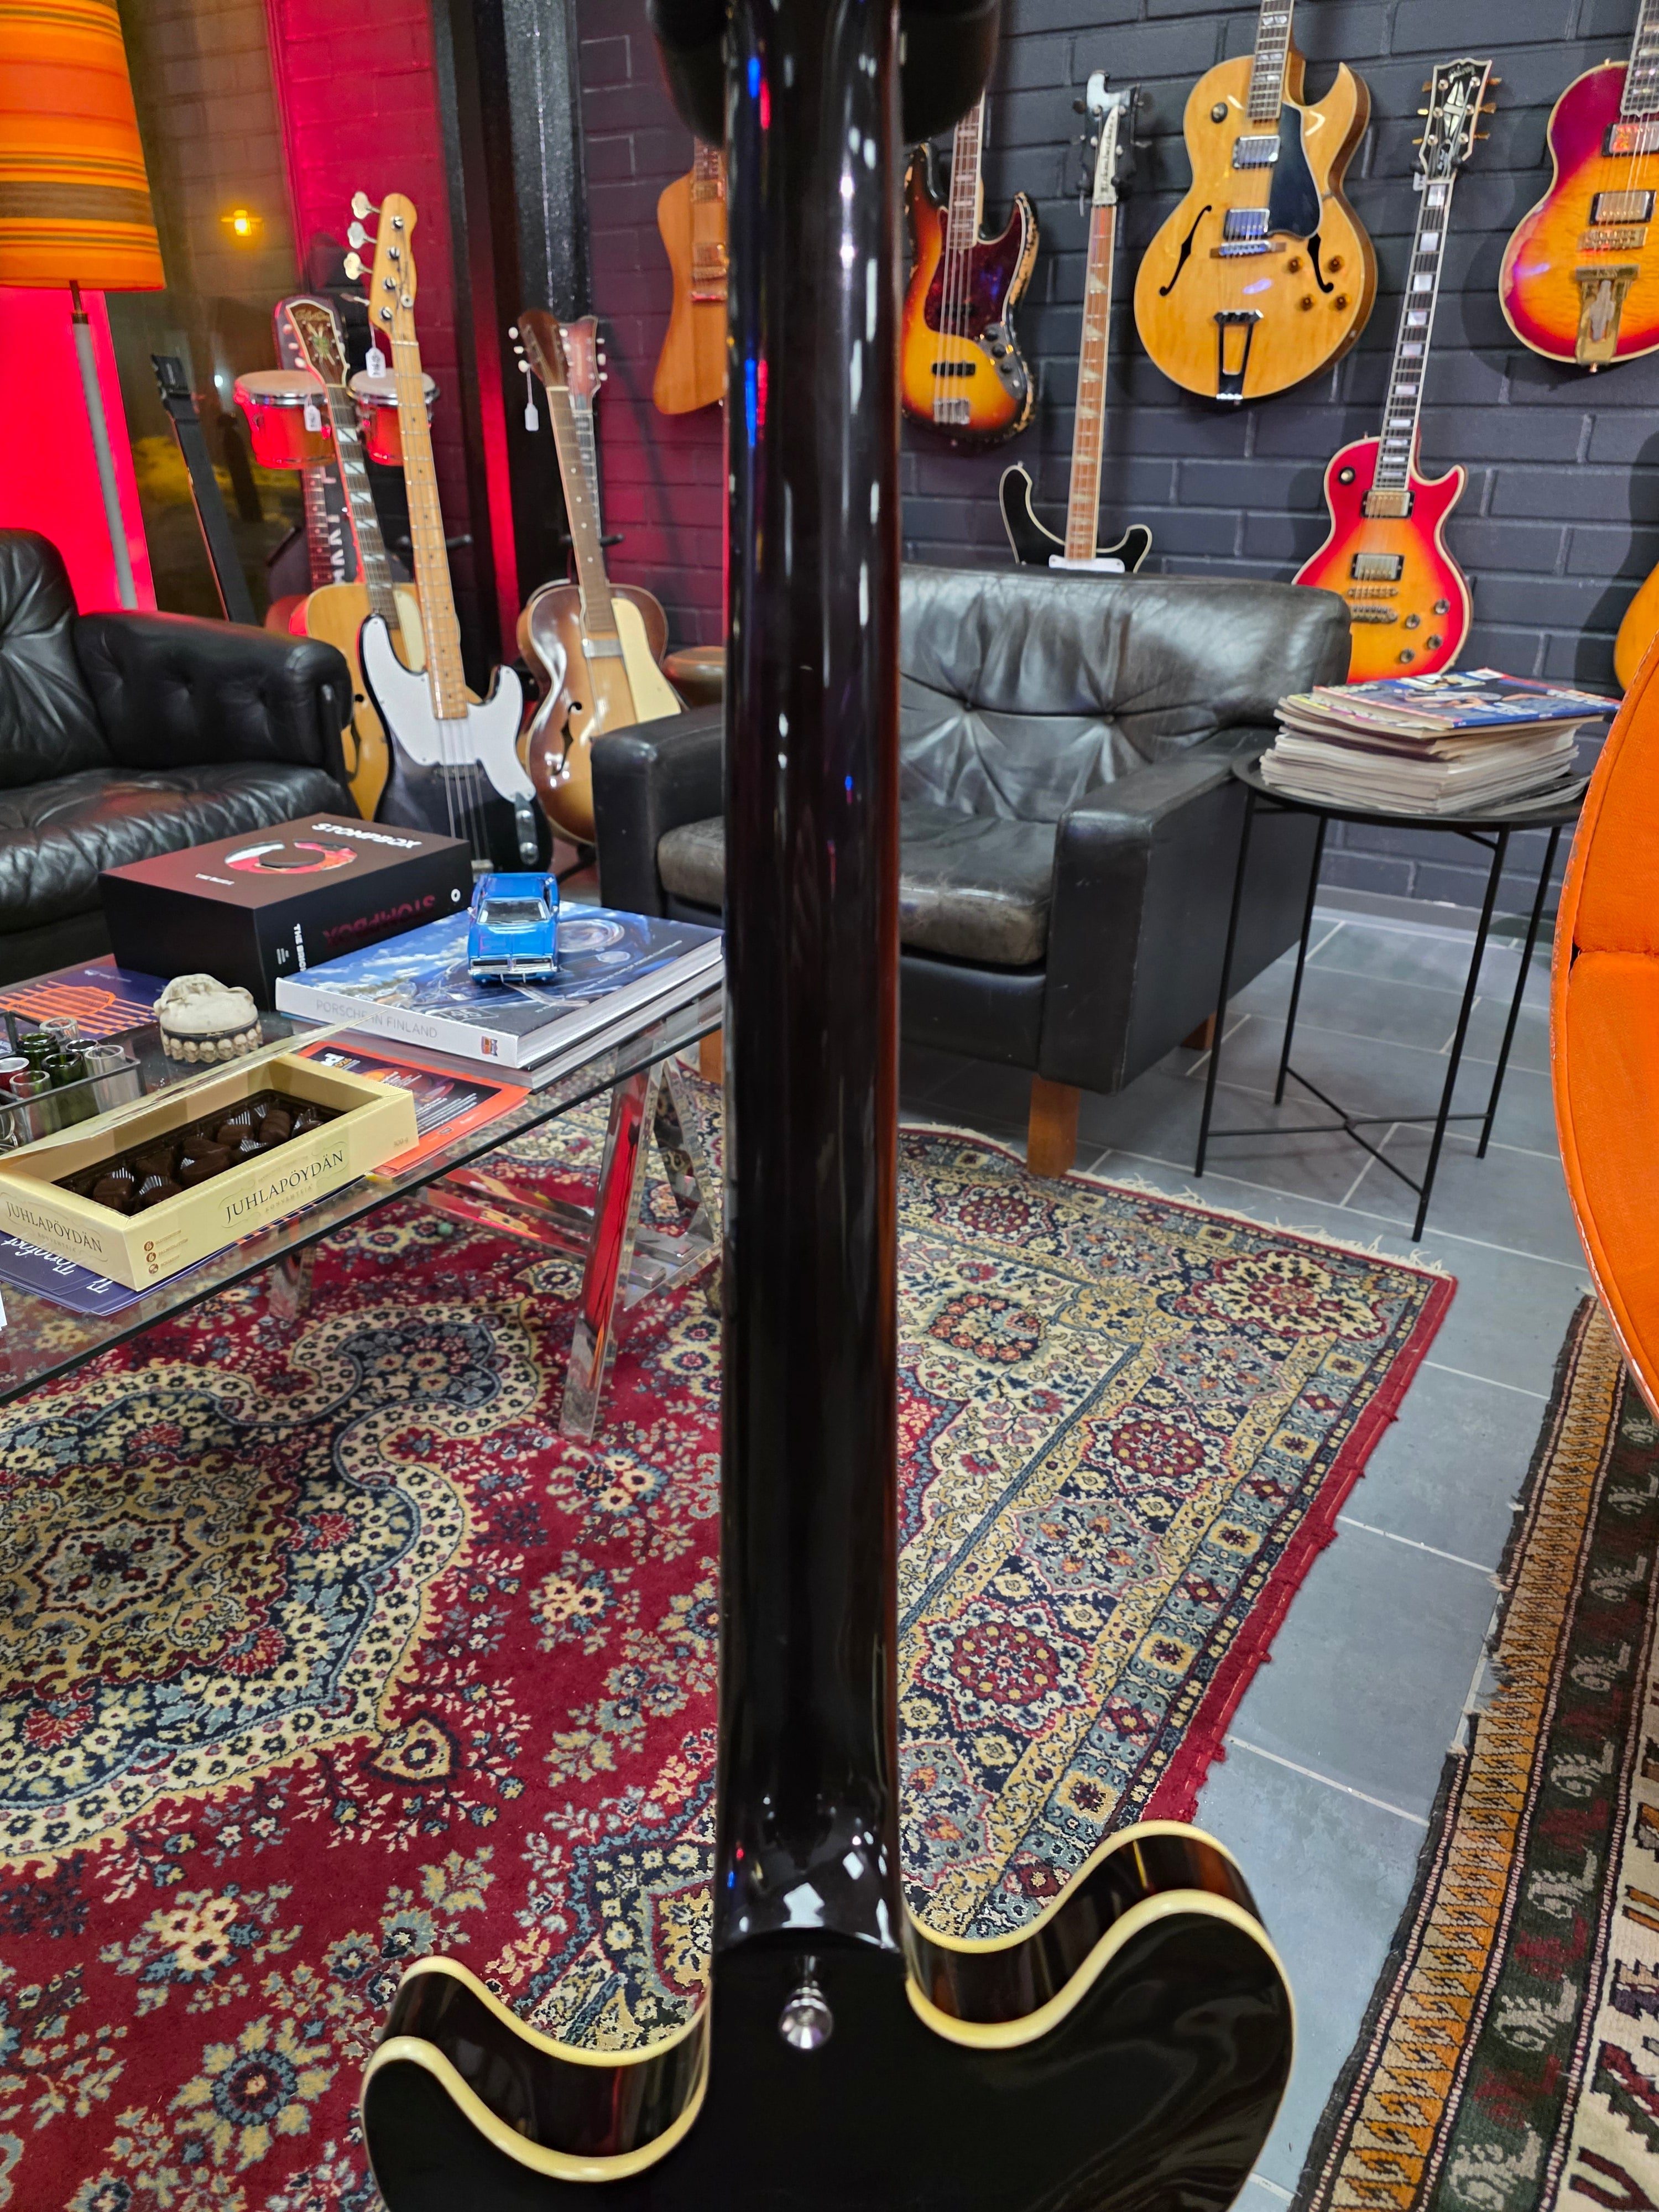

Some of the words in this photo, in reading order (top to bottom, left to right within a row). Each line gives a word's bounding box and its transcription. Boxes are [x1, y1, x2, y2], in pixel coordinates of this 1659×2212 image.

[312, 823, 422, 848] STOMPBOX
[294, 923, 303, 945] THE
[387, 1016, 437, 1039] FINLAND
[226, 1150, 343, 1223] JUHLAPÖYDÄN
[6, 1201, 102, 1253] JUHLAPÖYDÄN
